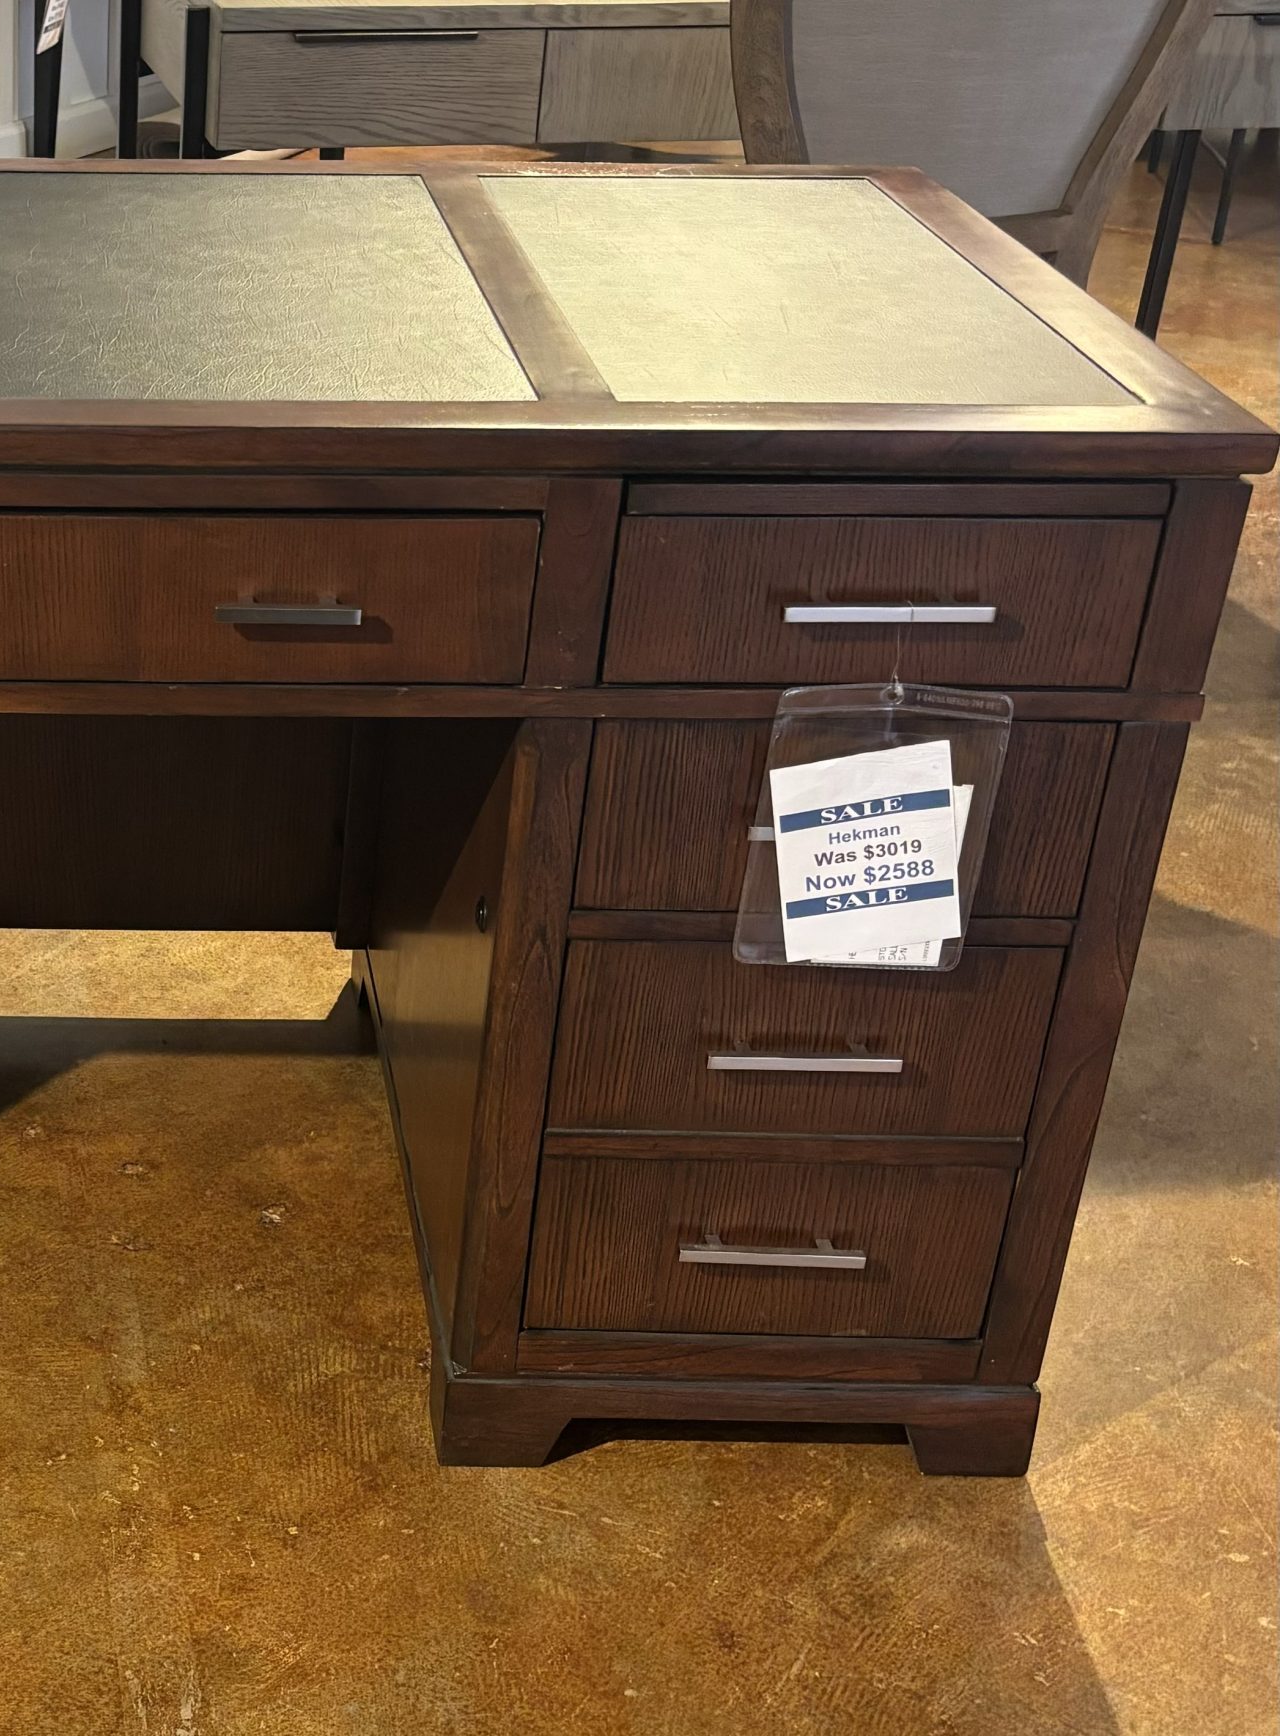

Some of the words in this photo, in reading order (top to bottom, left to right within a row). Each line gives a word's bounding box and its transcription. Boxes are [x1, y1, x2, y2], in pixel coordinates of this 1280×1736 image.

[821, 797, 902, 823] SALE
[829, 825, 900, 844] Hekman
[815, 851, 857, 866] Was
[863, 840, 922, 860] $3019
[806, 874, 855, 892] Now
[863, 860, 934, 885] $2588
[826, 887, 907, 911] SALE
